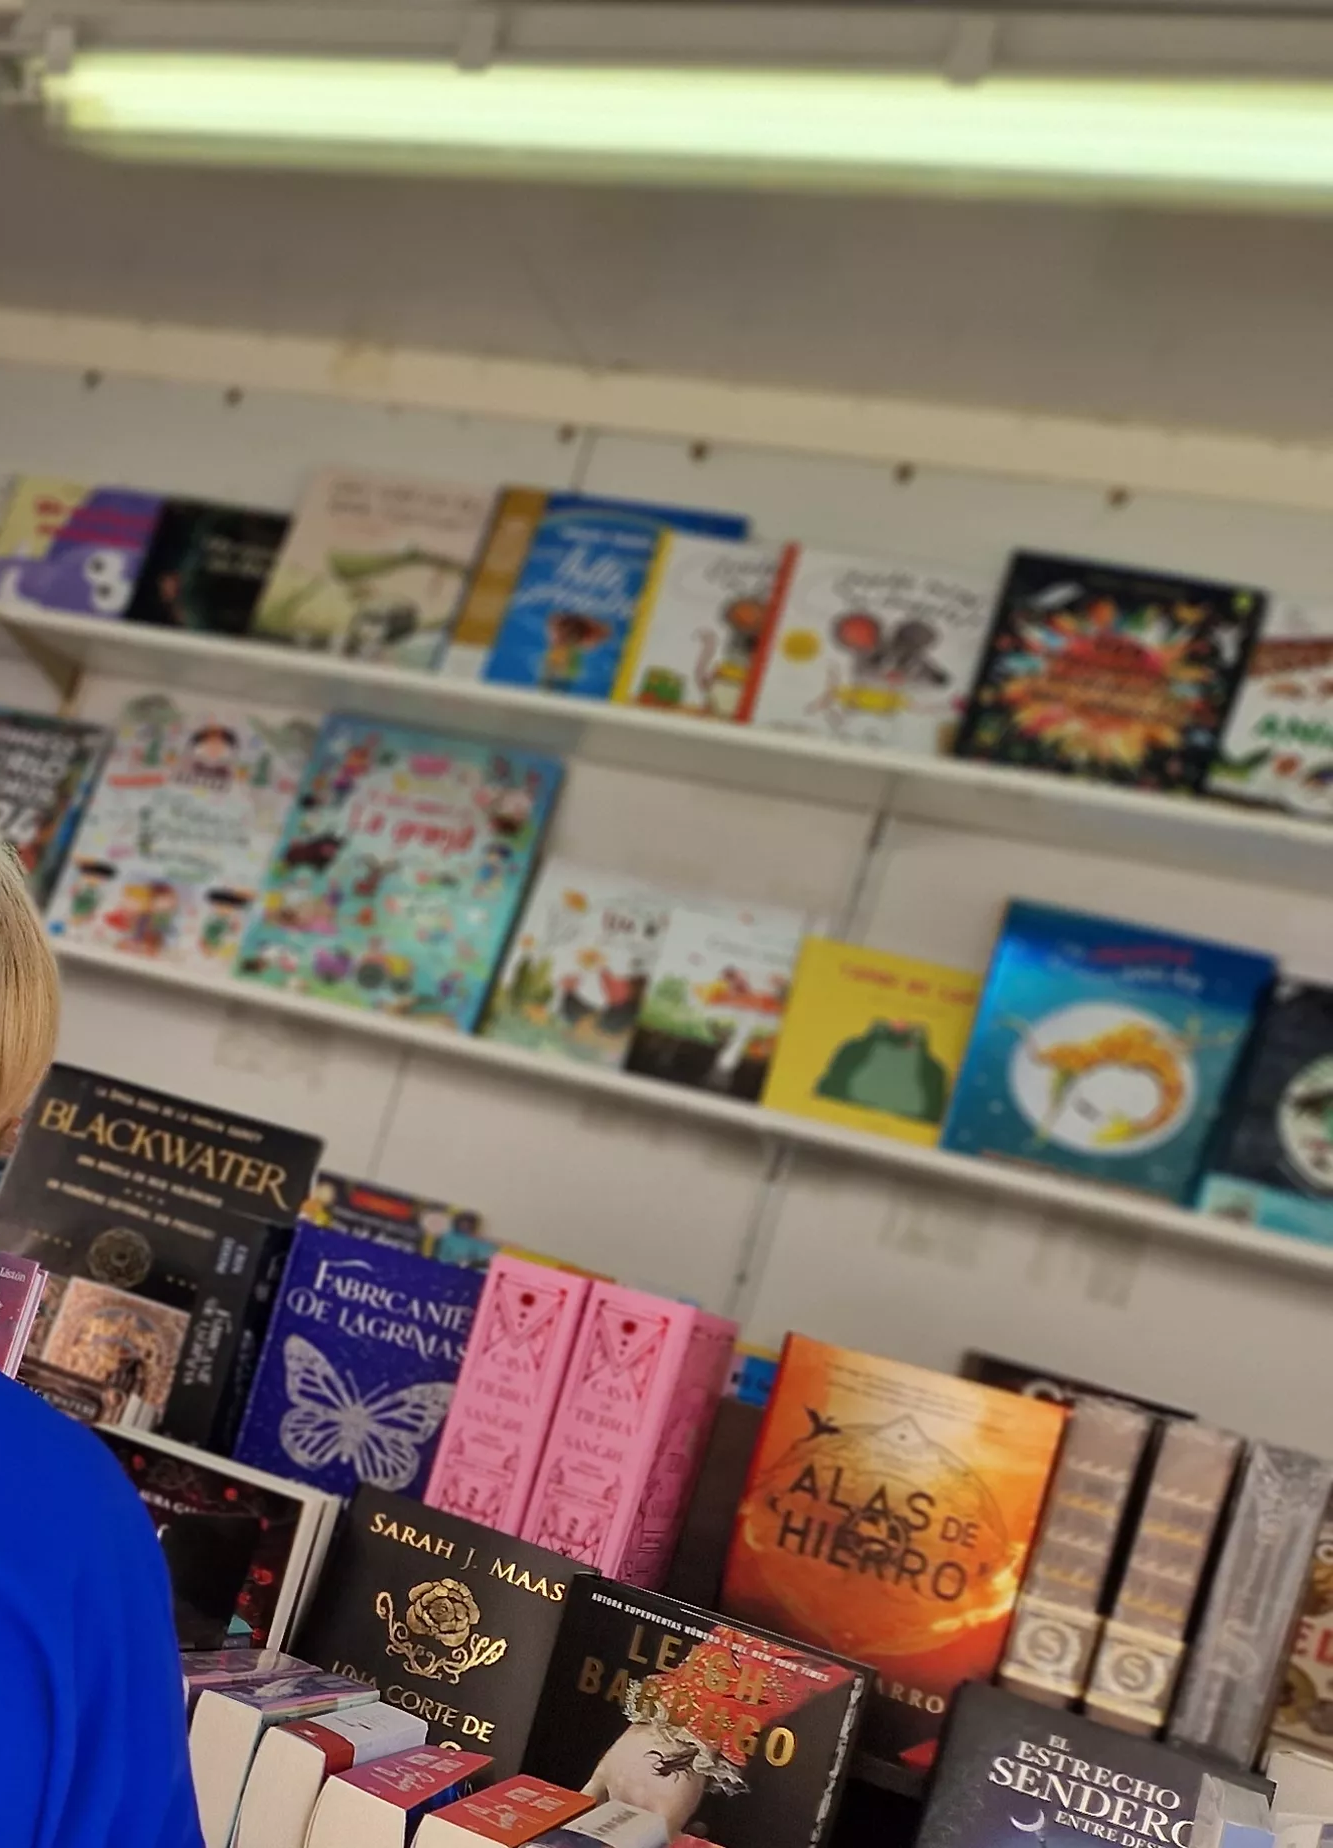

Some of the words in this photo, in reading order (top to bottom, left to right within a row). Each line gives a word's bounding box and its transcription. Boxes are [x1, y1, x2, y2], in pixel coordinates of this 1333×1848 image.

[39, 1098, 290, 1212] BLACKWATER
[0, 1266, 26, 1283] Listón
[286, 1286, 333, 1324] DE
[314, 1259, 473, 1333] FABRICANTE
[789, 1463, 936, 1532] ALAS
[939, 1516, 979, 1549] DE
[370, 1512, 456, 1561] SARAH
[459, 1546, 479, 1571] J.
[489, 1557, 566, 1602] MAAS
[777, 1510, 968, 1602] HIERRO
[591, 1592, 623, 1611] AUTORA
[624, 1603, 682, 1632] SUPERVENTAS
[684, 1623, 720, 1645] NÚMERO
[731, 1642, 749, 1656] DEL
[751, 1648, 772, 1664] NEW
[773, 1655, 799, 1673] YORK
[800, 1664, 831, 1683] TIMES
[627, 1624, 770, 1705] LEIGH
[386, 1684, 459, 1728] CORTE
[462, 1715, 496, 1743] DE
[577, 1656, 797, 1767] BARDUGO
[1048, 1734, 1072, 1752] EL
[1015, 1740, 1180, 1810] ESTRECHO
[1054, 1810, 1118, 1842] ENTRE
